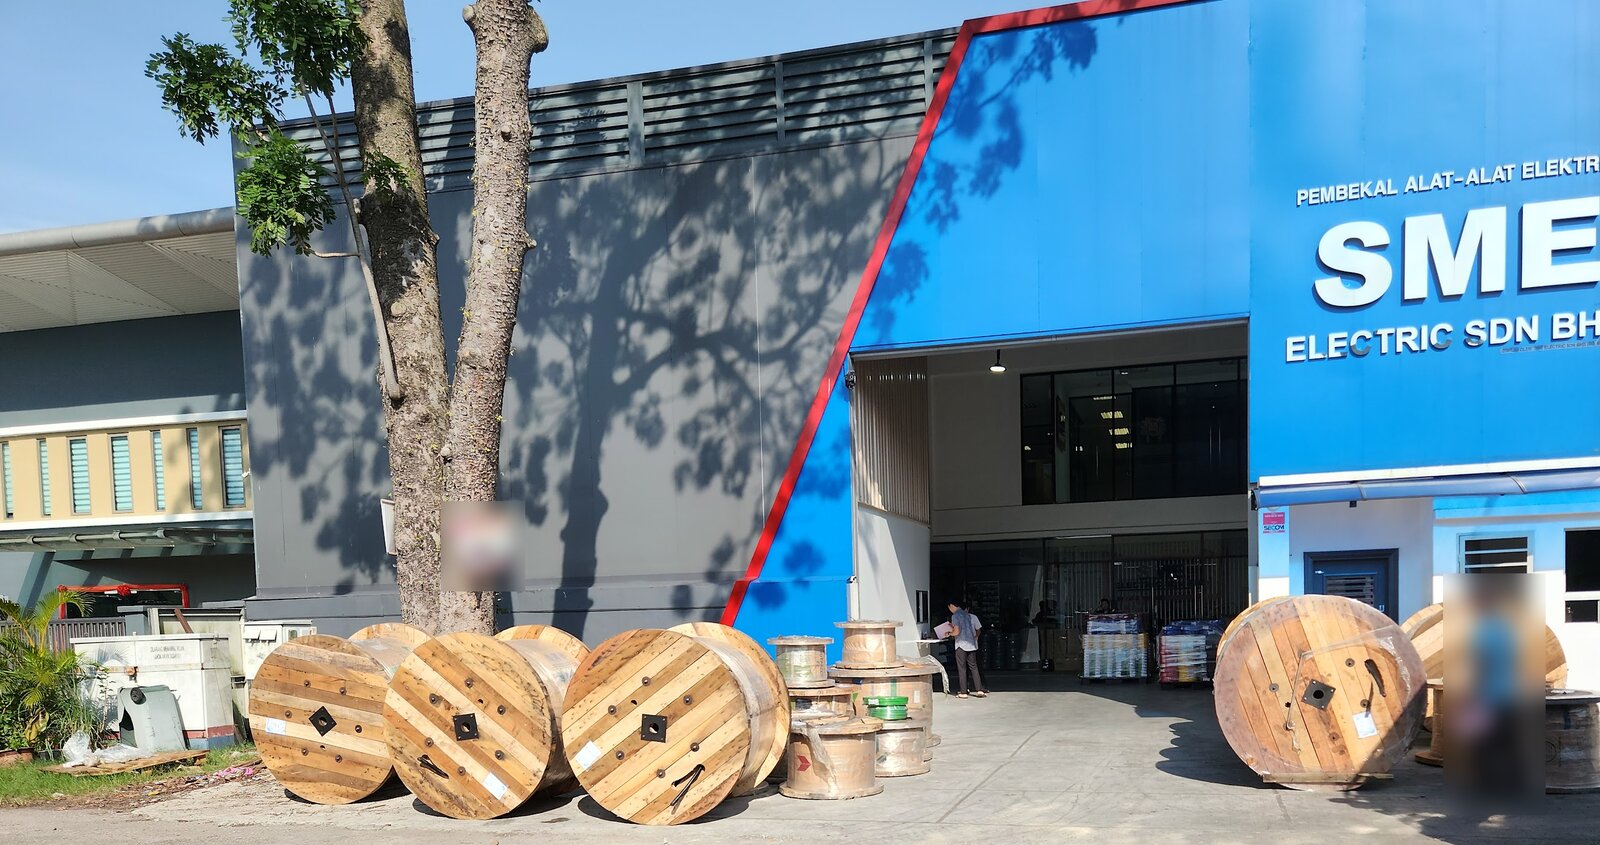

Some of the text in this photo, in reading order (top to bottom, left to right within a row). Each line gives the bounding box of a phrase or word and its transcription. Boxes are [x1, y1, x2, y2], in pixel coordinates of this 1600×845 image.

[1296, 178, 1398, 206] PEMBEKAL
[1404, 163, 1517, 193] ALAT-ALAT
[1311, 195, 1600, 310] SME
[1285, 309, 1600, 363] ELECTRIC SDN BH
